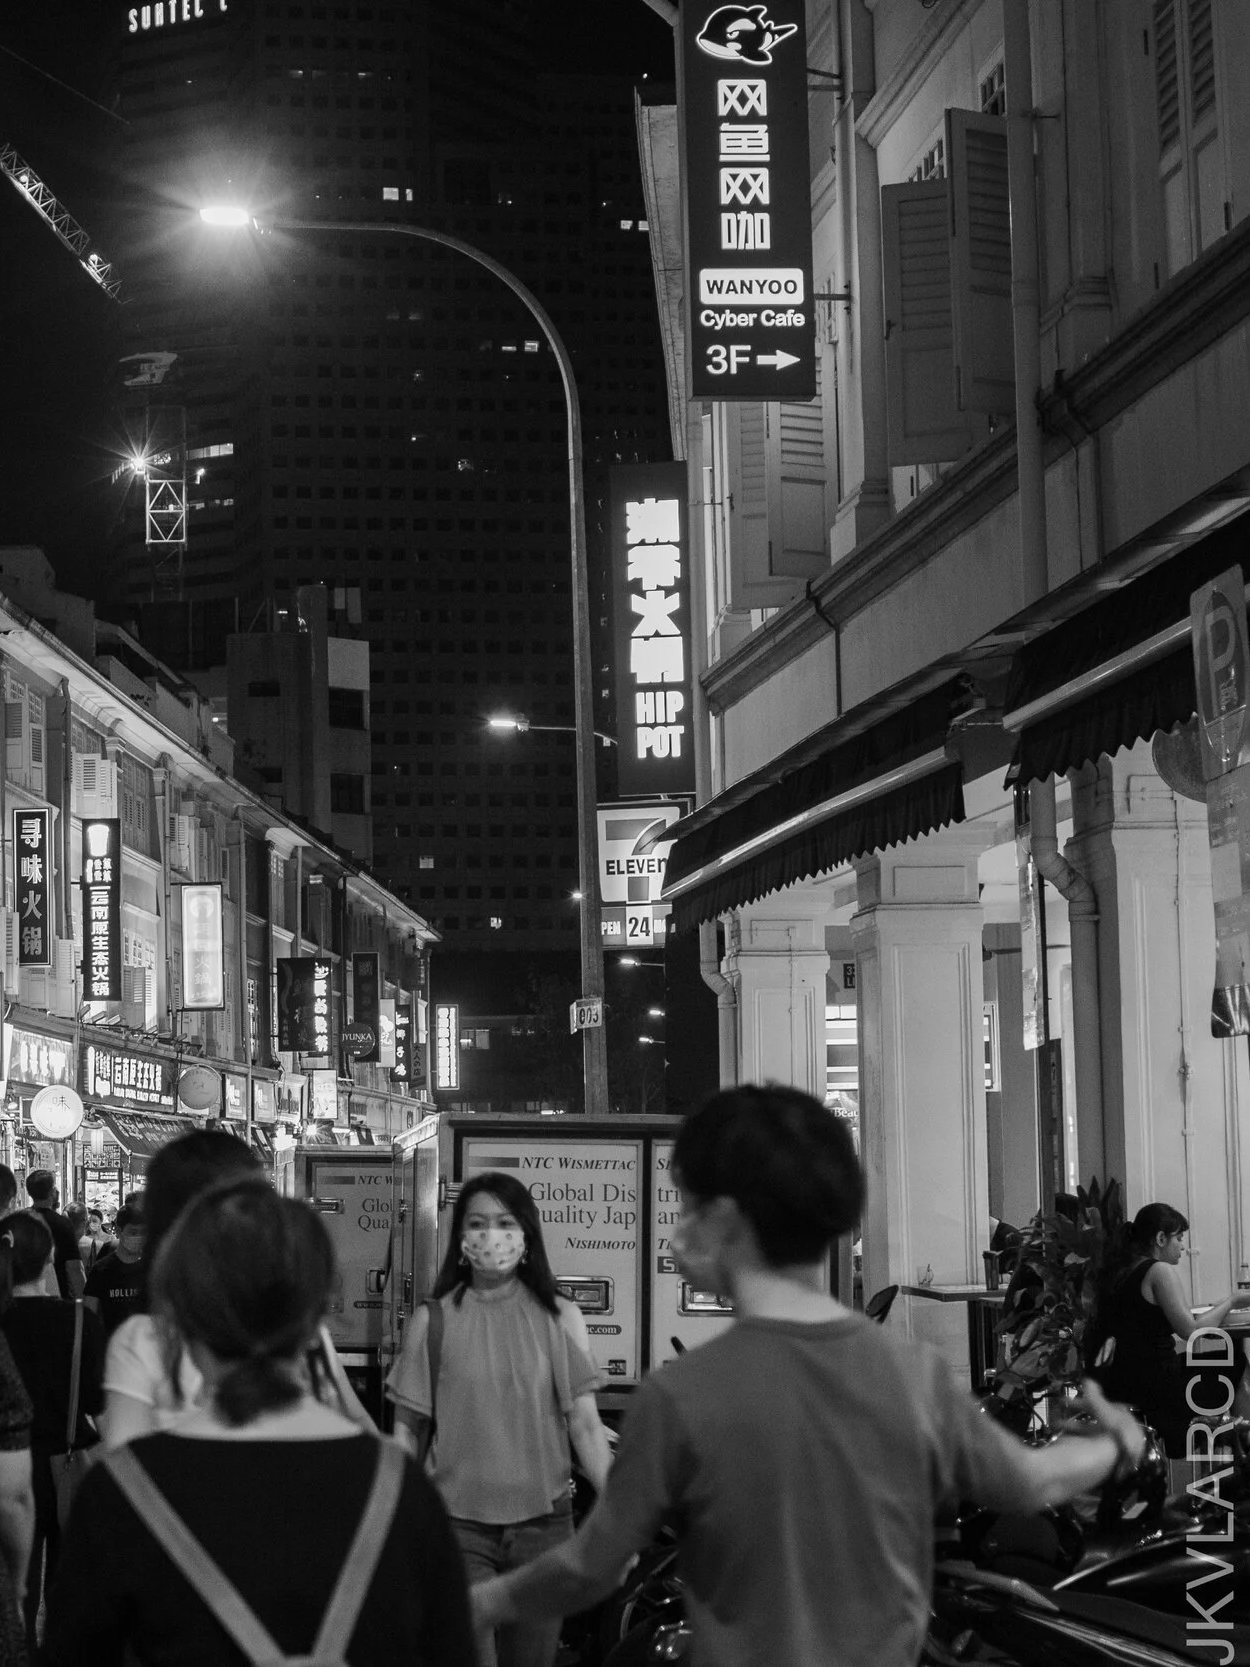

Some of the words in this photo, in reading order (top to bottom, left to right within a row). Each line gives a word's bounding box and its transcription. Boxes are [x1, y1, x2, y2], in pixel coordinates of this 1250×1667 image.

[717, 79, 770, 250] 网鱼网咖
[706, 279, 798, 295] WANYOO
[700, 310, 757, 330] Cyber
[760, 309, 806, 328] Cafe
[706, 344, 751, 375] 3F
[636, 691, 685, 725] HIP
[637, 725, 685, 759] POT
[20, 818, 43, 956] 寻味火锅
[601, 921, 621, 935] PEN
[628, 917, 650, 937] 24
[342, 1033, 372, 1041] JYUNKA
[522, 1157, 553, 1169] NTC
[529, 1182, 594, 1201] Global
[603, 1183, 637, 1202] Dis
[361, 1198, 391, 1213] Glo
[358, 1214, 390, 1232] Qua
[541, 1205, 597, 1229] uality
[603, 1206, 636, 1230] Jap
